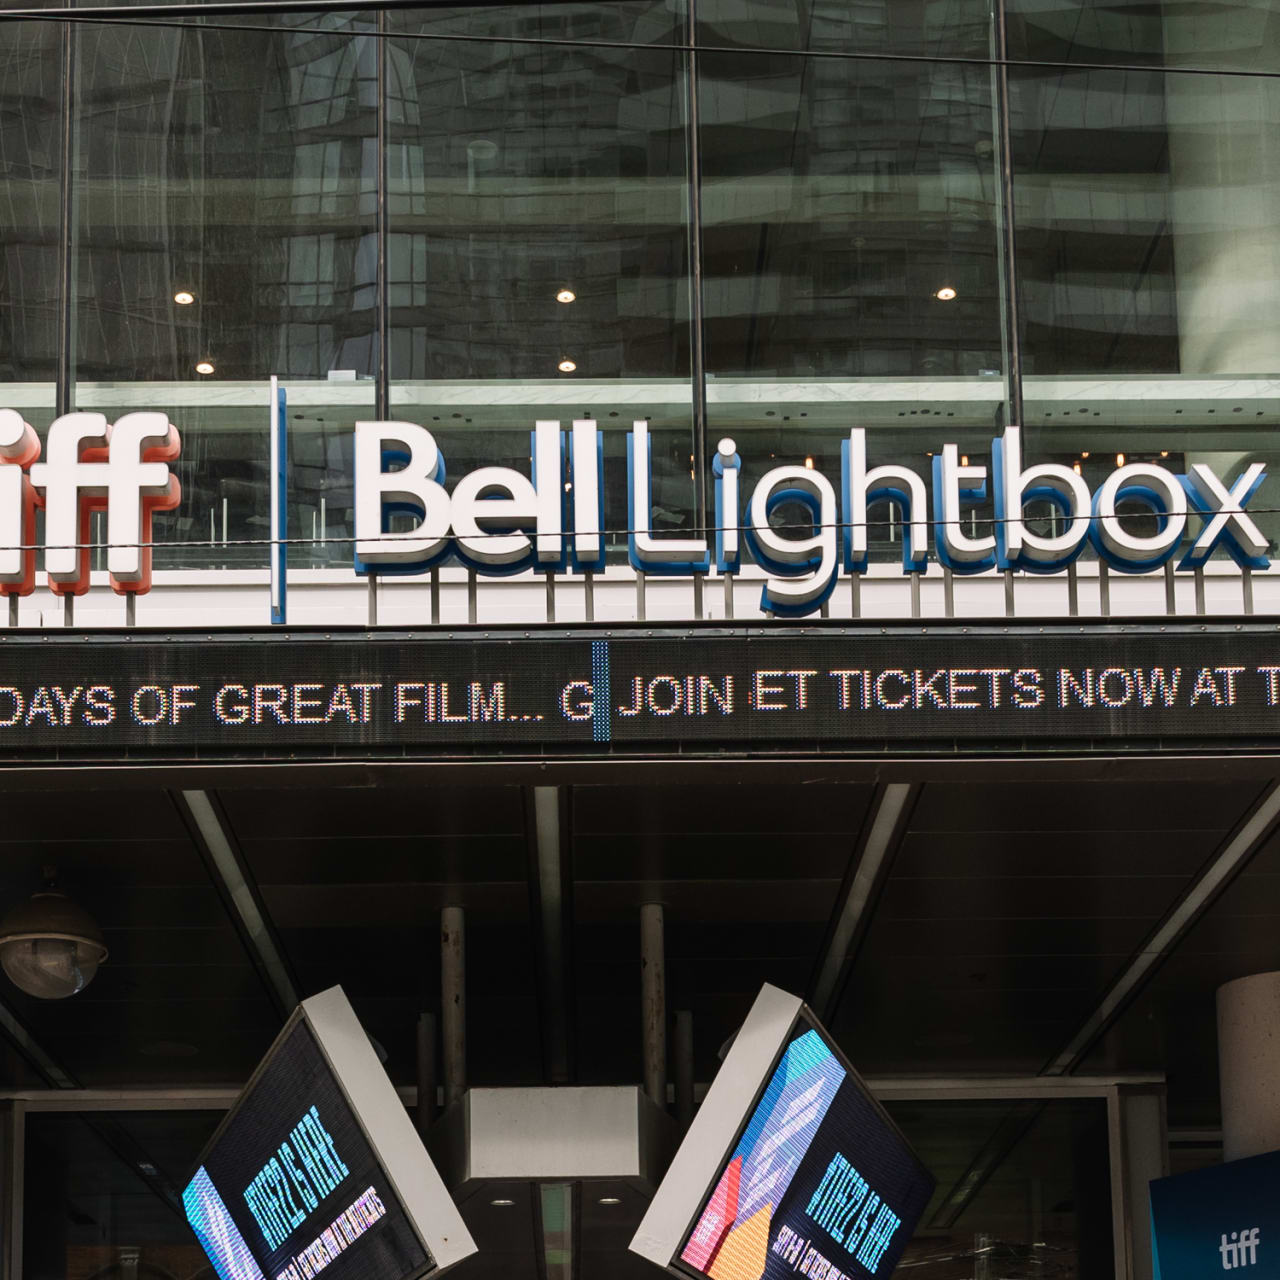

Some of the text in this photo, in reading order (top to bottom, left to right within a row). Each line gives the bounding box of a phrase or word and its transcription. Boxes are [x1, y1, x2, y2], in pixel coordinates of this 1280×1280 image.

[354, 418, 1270, 618] Bell Lightbox
[130, 684, 199, 725] OF
[213, 683, 382, 724] GREAT
[394, 681, 544, 723] FILM...
[618, 675, 733, 717] JOIN
[748, 669, 817, 711] ET
[830, 668, 1044, 710] TICKETS
[1057, 667, 1181, 708] NOW
[1191, 666, 1245, 706] AT
[277, 1141, 319, 1213] IS
[290, 1105, 350, 1199] HERE
[844, 1191, 880, 1254] IS
[856, 1203, 901, 1275] HERE
[1220, 1227, 1260, 1270] tiff
